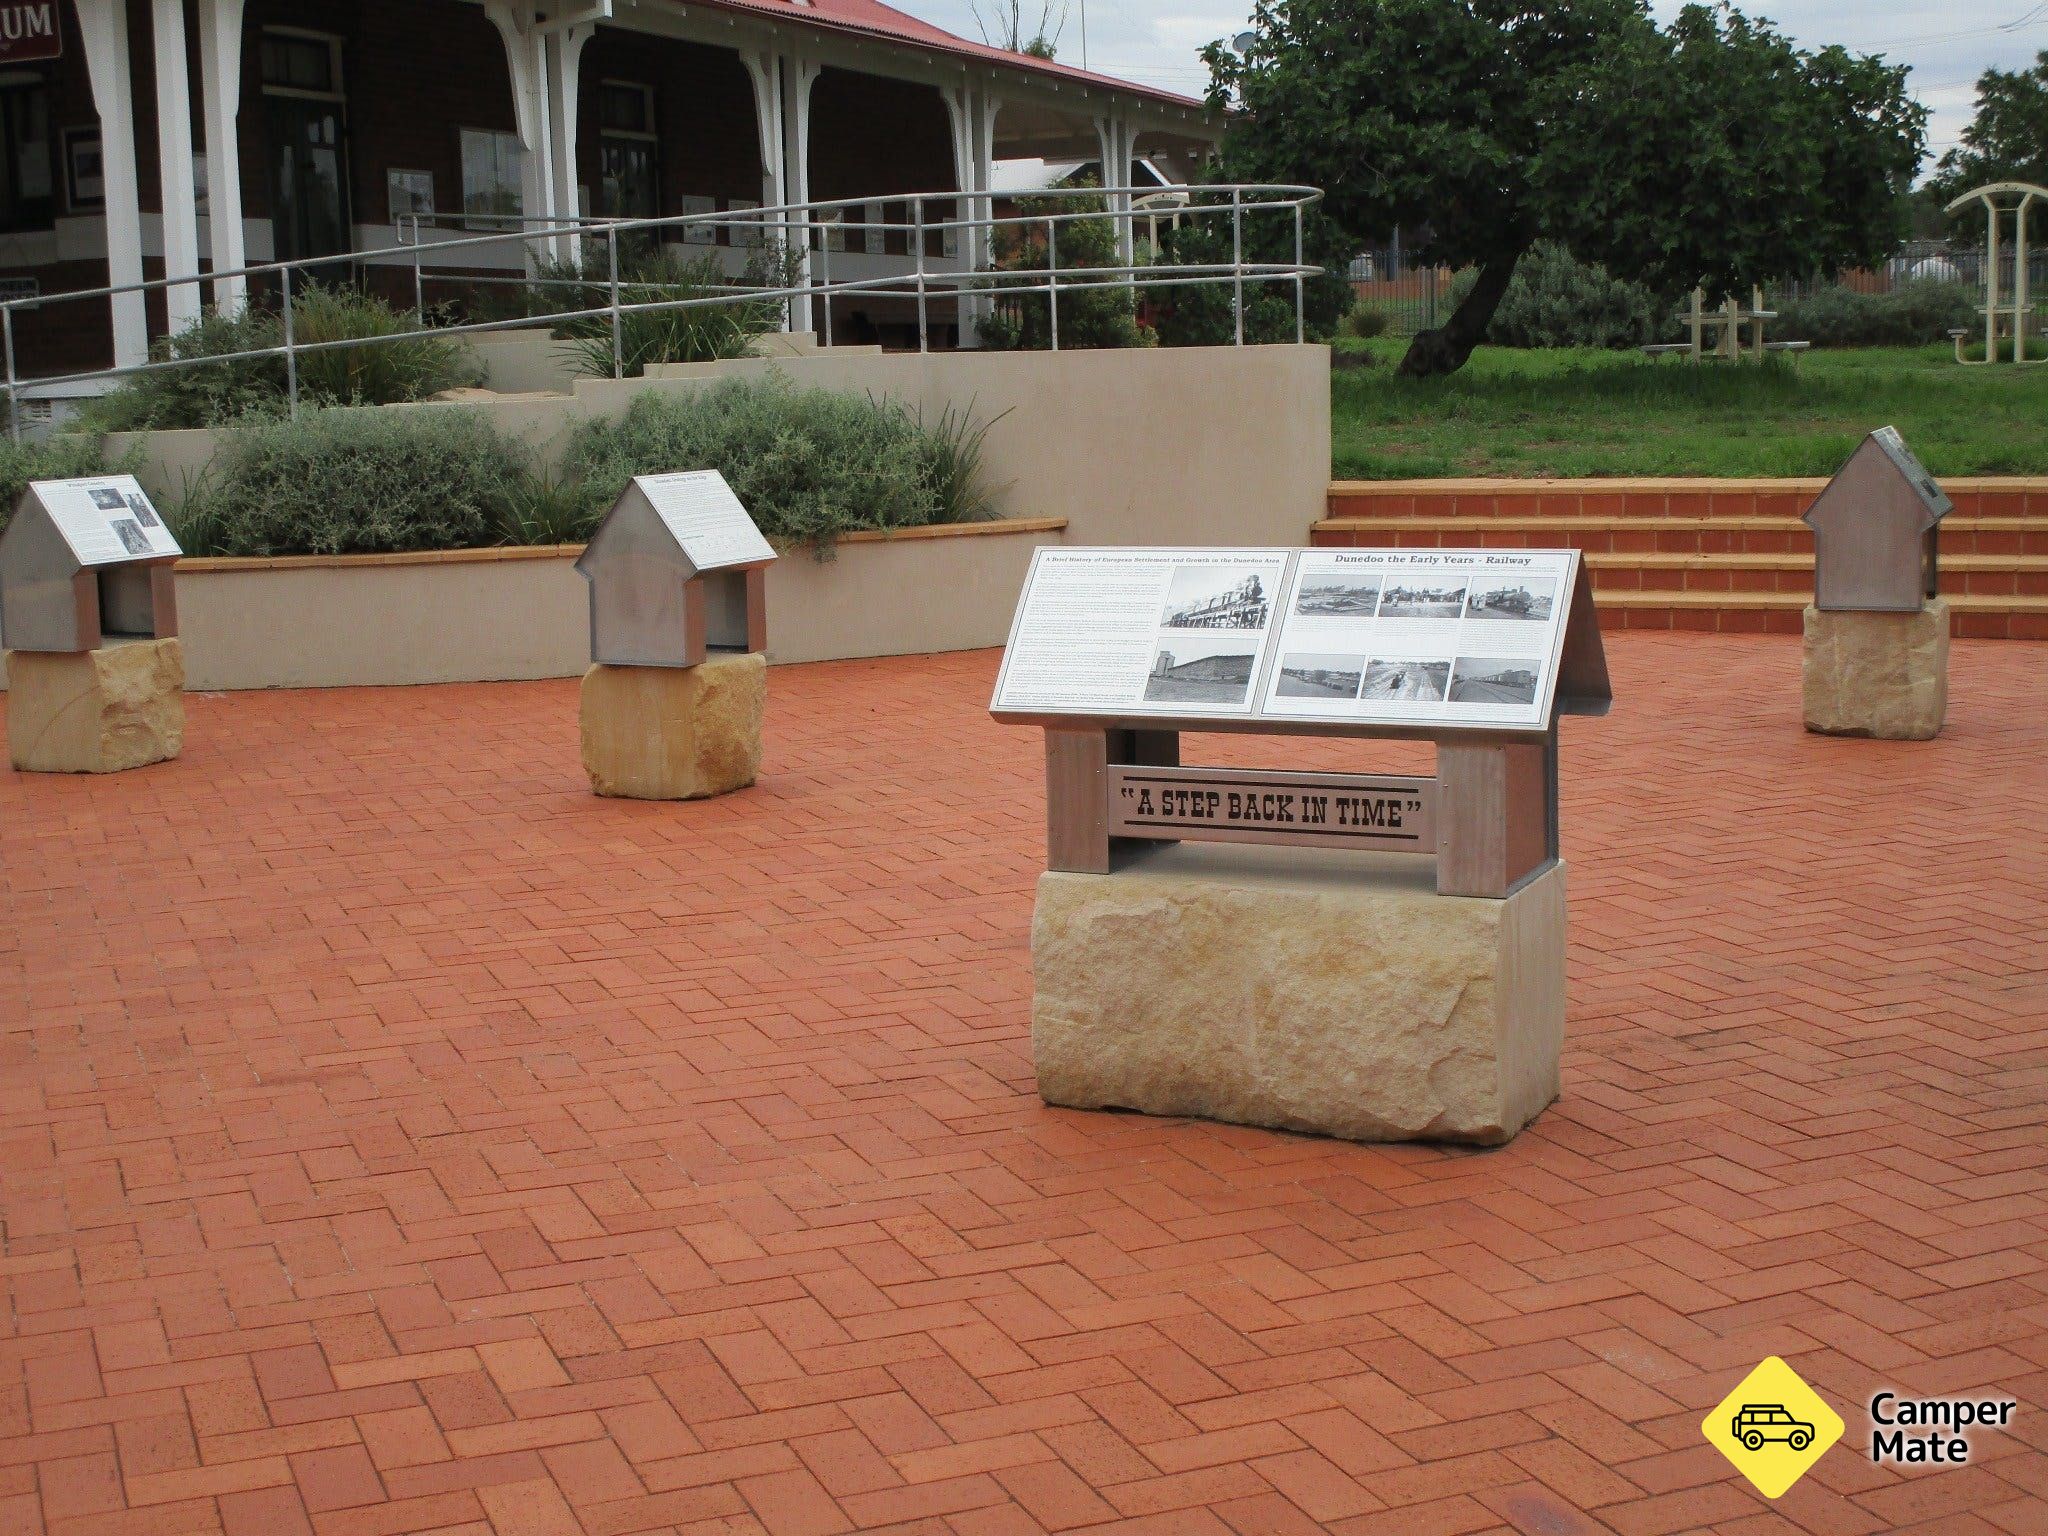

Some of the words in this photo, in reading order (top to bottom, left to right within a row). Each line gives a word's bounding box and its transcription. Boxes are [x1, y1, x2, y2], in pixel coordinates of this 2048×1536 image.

[1335, 555, 1384, 563] Dunedoo
[1388, 555, 1406, 563] the
[1410, 555, 1440, 565] Early
[1443, 556, 1475, 564] Years
[1485, 556, 1532, 566] Railway
[1162, 789, 1220, 818] STEP
[1227, 792, 1294, 822] BACK
[1302, 795, 1328, 824] IN
